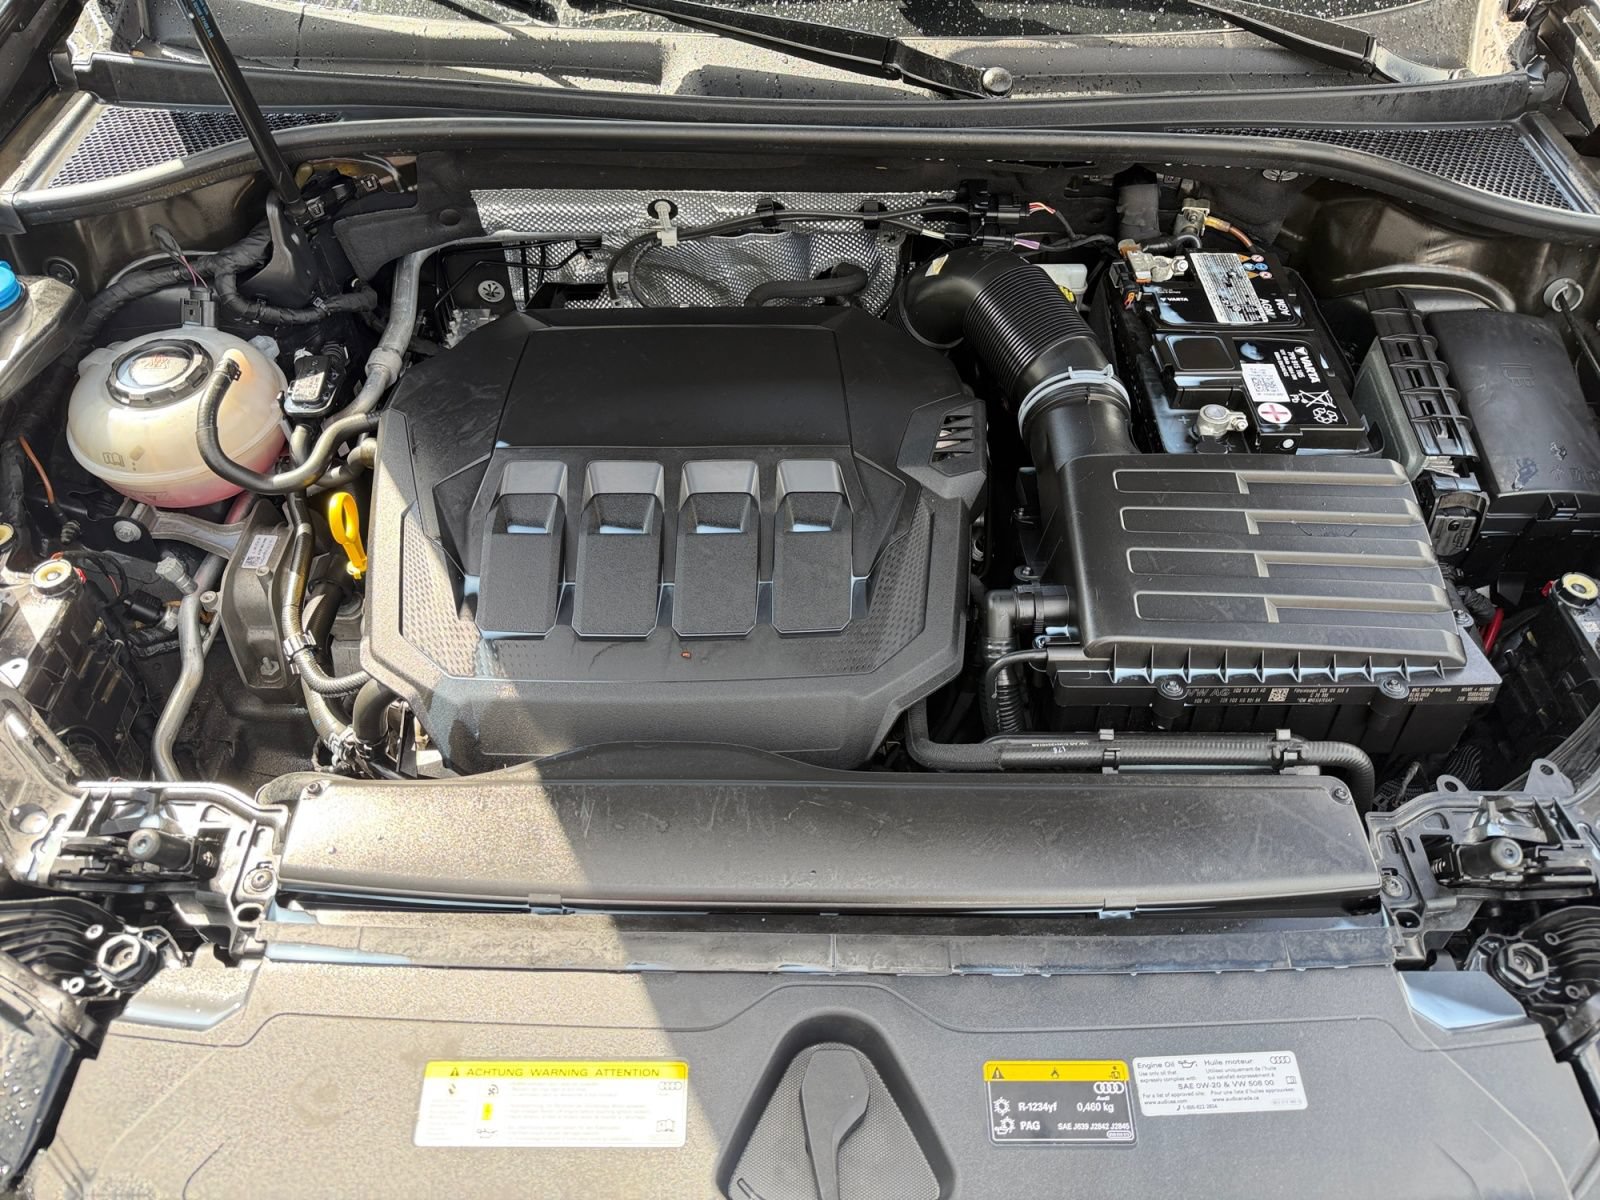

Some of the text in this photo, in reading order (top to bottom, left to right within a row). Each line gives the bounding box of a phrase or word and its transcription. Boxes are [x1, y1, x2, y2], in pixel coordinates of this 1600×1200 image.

[1260, 298, 1276, 317] AGM
[1275, 298, 1292, 316] AGM
[1300, 356, 1320, 384] VARTA
[1290, 394, 1300, 403] Pb
[1210, 688, 1230, 697] AG
[466, 1068, 660, 1077] ACHTUNG WARNING ATTENTION
[1018, 1102, 1114, 1113] R-1234yf 0,460 kg
[1020, 1121, 1040, 1130] PAG
